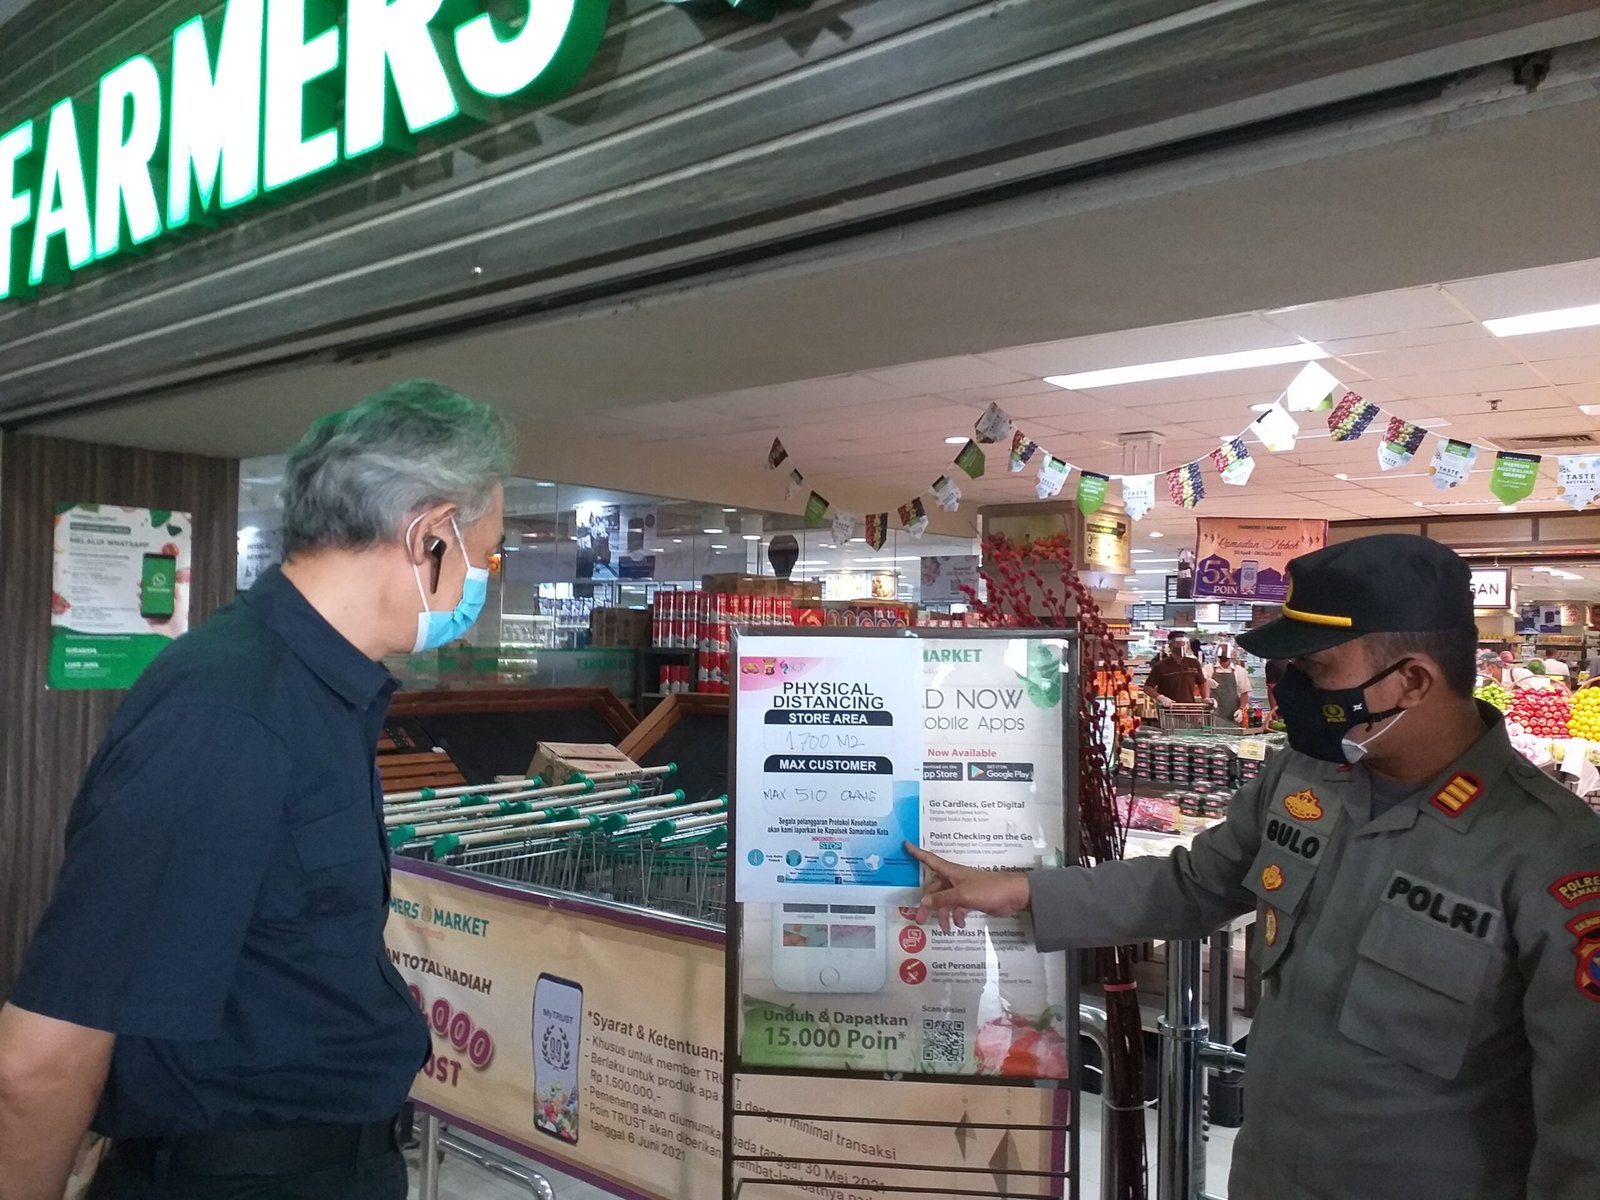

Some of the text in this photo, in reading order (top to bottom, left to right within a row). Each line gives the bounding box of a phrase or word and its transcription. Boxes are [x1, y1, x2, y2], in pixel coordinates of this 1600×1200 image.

[1218, 537, 1260, 549] Ramadan
[1213, 585, 1239, 595] POIN
[783, 682, 874, 695] PHYSICAL
[773, 695, 884, 710] DISTANCING
[956, 688, 1024, 710] NOW
[789, 713, 868, 725] STORE AREA
[924, 715, 1025, 734] obile Apps
[928, 748, 997, 758] Now Available
[780, 759, 876, 772] MAX CUSTOMER
[924, 770, 958, 780] pp Store
[986, 770, 1030, 781] Google Play
[763, 789, 786, 801] MAX
[795, 788, 828, 802] 510
[929, 800, 940, 808] Go
[942, 800, 979, 809] Cardless,
[997, 801, 1025, 810] Digital
[768, 826, 780, 834] akan
[780, 826, 794, 834] kami
[794, 826, 817, 836] laporkan
[778, 818, 796, 827] Segala
[796, 818, 828, 828] pelanggaran
[850, 819, 878, 828] Kesehatan
[930, 832, 952, 840] Point
[953, 832, 990, 842] Checking
[1005, 832, 1020, 840] the
[1020, 833, 1032, 841] Go
[1558, 875, 1600, 896] POLRE
[1386, 876, 1493, 939] POLRI
[434, 908, 489, 937] MARKET
[402, 952, 492, 995] TOTAL HADIAH
[932, 962, 946, 970] Get
[764, 1010, 908, 1027] Unduh & Dapatkan
[636, 1024, 644, 1041] &
[648, 1028, 723, 1063] Ketentuan:
[765, 1027, 840, 1048] 15.000
[592, 1035, 626, 1057] Khusus
[628, 1048, 654, 1066] untuk
[656, 1058, 701, 1079] member
[424, 1053, 462, 1088] UST
[591, 1069, 602, 1084] Rp
[591, 1052, 624, 1074] Berlaku
[627, 1066, 654, 1084] untuk
[657, 1076, 696, 1095] produk
[699, 1088, 718, 1102] apa
[590, 1085, 639, 1114] Pemenang
[642, 1104, 666, 1120] akan
[669, 1112, 721, 1140] diumumka
[590, 1102, 609, 1116] Poin
[611, 1110, 646, 1130] TRUST
[649, 1123, 674, 1138] akan
[676, 1132, 721, 1159] diberikan
[789, 1117, 897, 1161] minimal transaksi
[591, 1120, 686, 1162] tanggal 6 Juni 2021
[805, 1164, 820, 1177] 30
[825, 1168, 848, 1185] Mei
